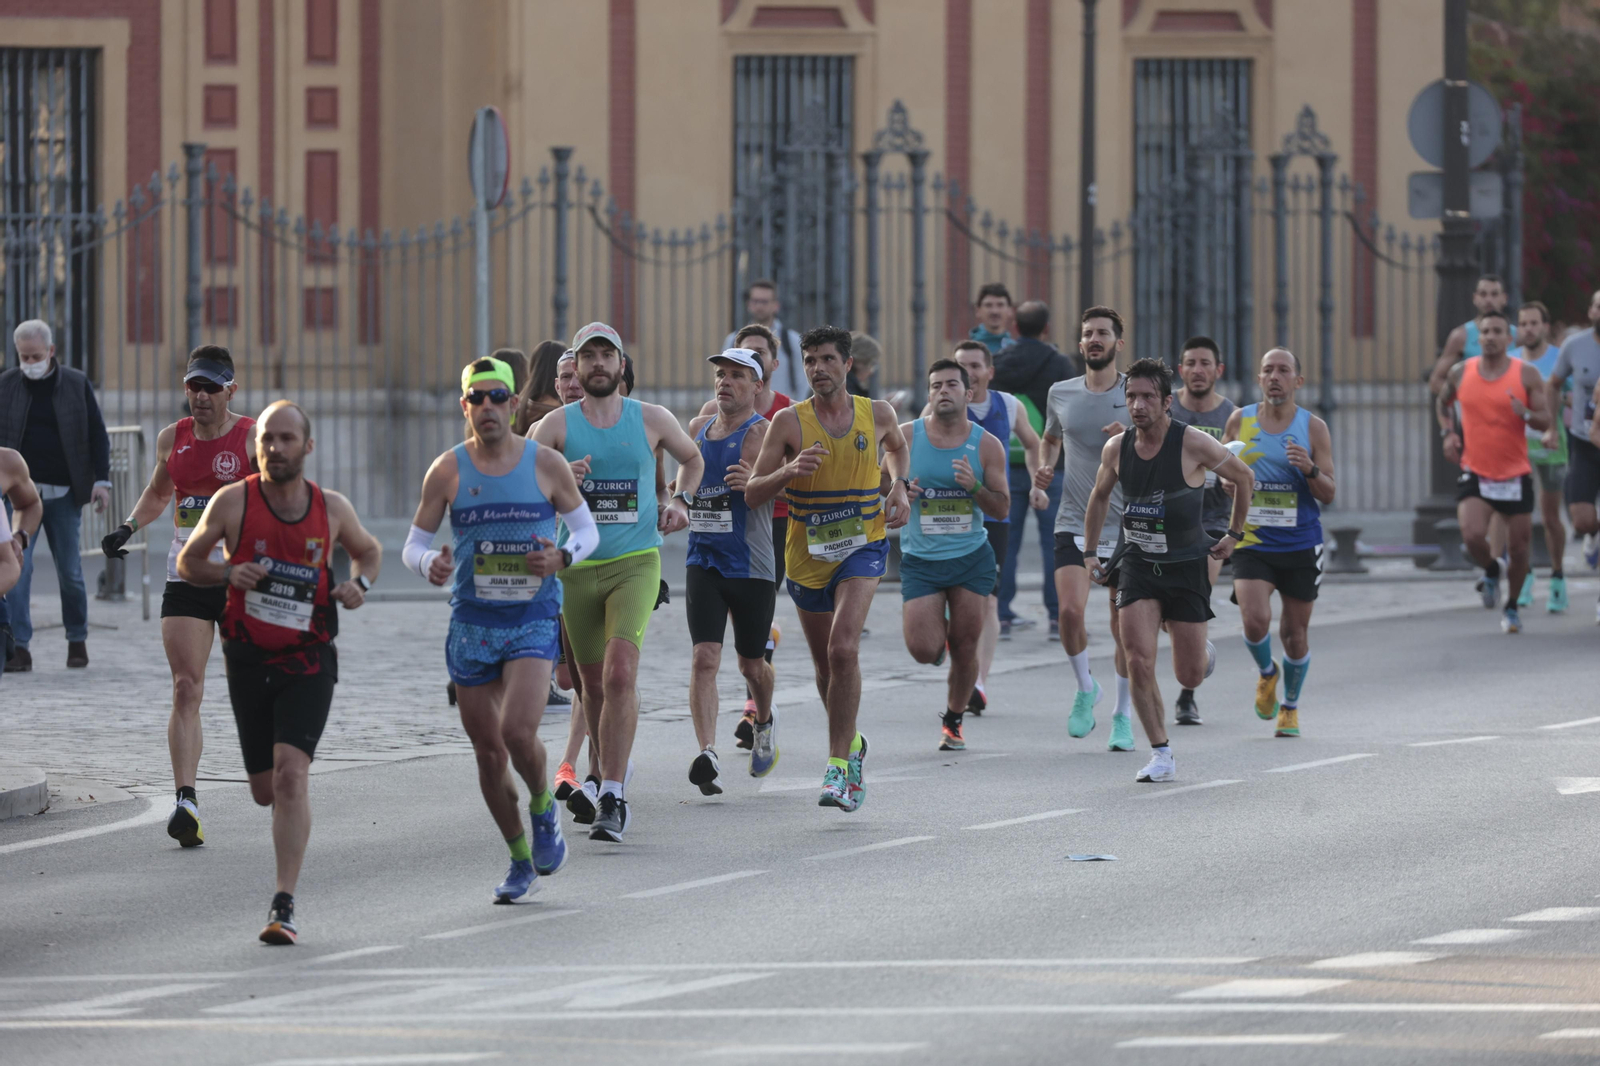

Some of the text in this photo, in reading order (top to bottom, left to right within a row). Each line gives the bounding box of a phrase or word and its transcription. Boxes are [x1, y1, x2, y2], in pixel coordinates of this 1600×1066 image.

[597, 482, 631, 490] ZURICH
[1263, 483, 1293, 491] ZURICH
[596, 500, 618, 509] 2963
[483, 507, 541, 520] Montellano
[1130, 506, 1160, 515] ZURICH
[703, 512, 722, 520] NUNES
[822, 508, 855, 523] ZURICH
[828, 529, 843, 539] 991
[1131, 532, 1153, 541] RICARDO
[496, 543, 534, 552] ZURICH
[824, 539, 853, 552] PACHECO
[274, 562, 314, 579] ZURICH
[497, 563, 520, 573] 1228
[489, 578, 528, 586] JUAN SIWI
[269, 582, 296, 598] 2819
[260, 596, 299, 612] MARCELO
